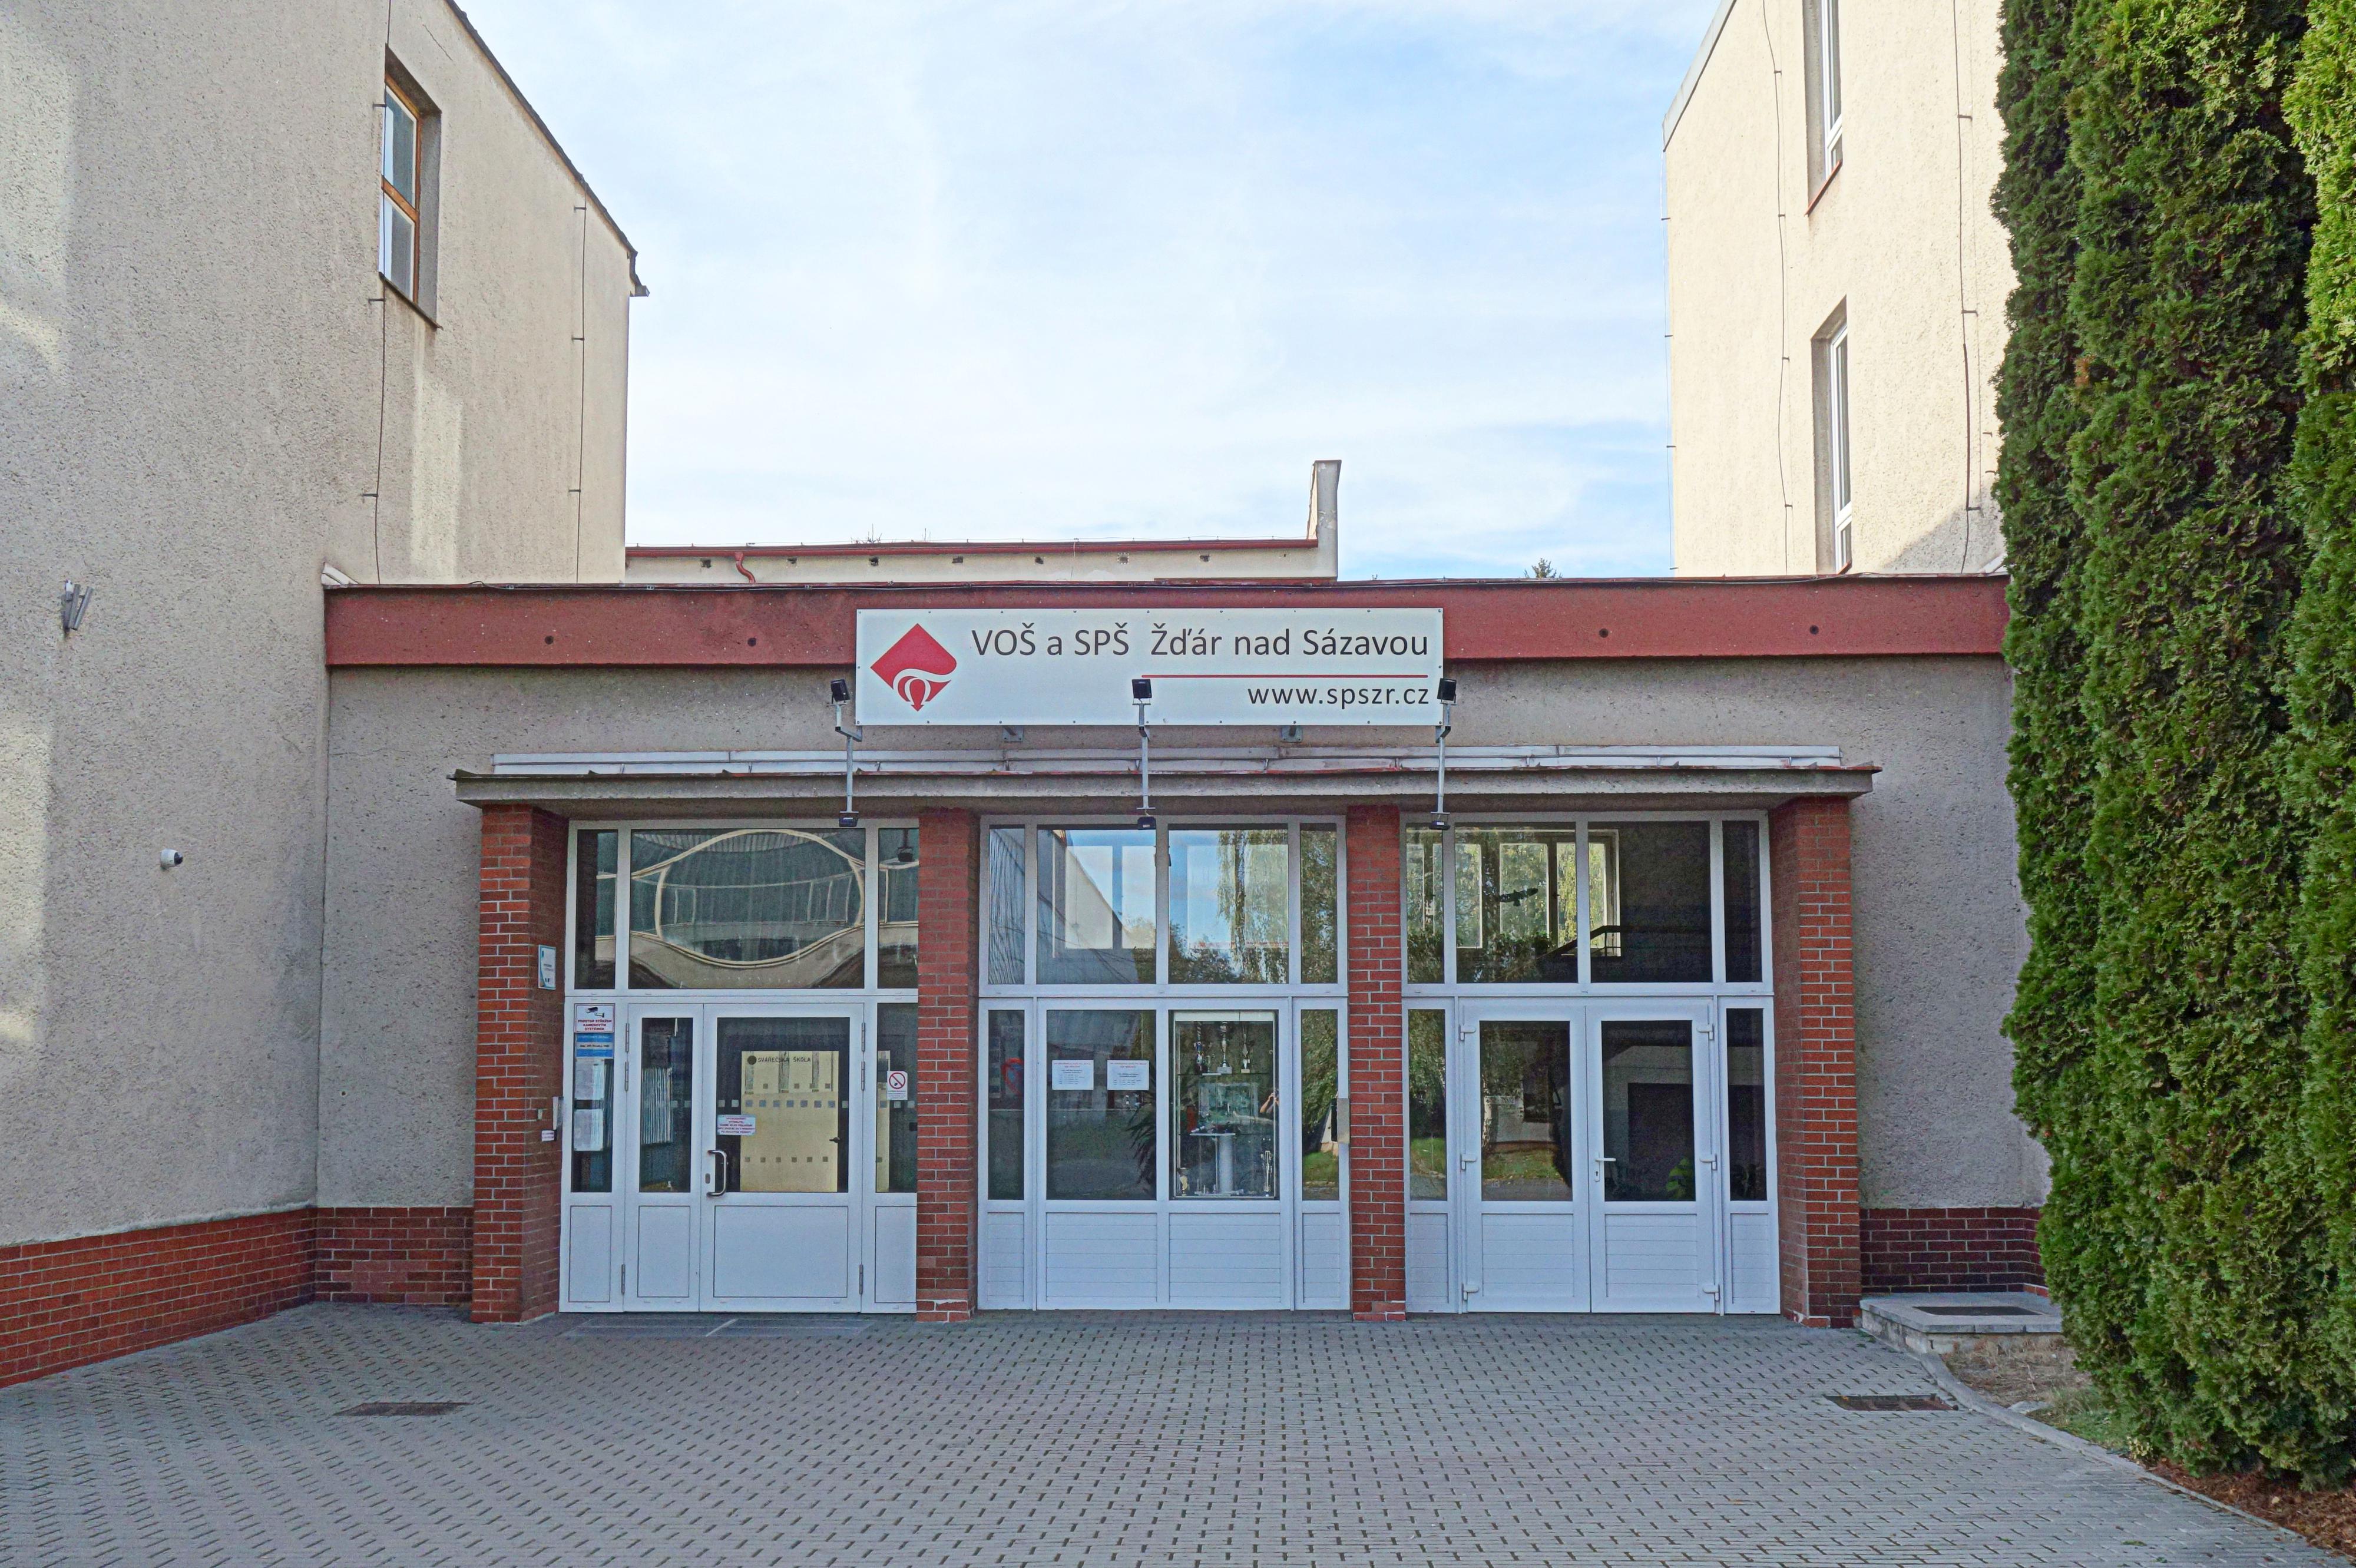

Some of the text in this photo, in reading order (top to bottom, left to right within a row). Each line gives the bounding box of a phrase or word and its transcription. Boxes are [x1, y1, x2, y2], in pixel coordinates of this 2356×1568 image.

[971, 622, 1428, 656] VOŠ a SPŠ Žďár nad Sázavou
[1248, 688, 1429, 710] www.spszr.cz
